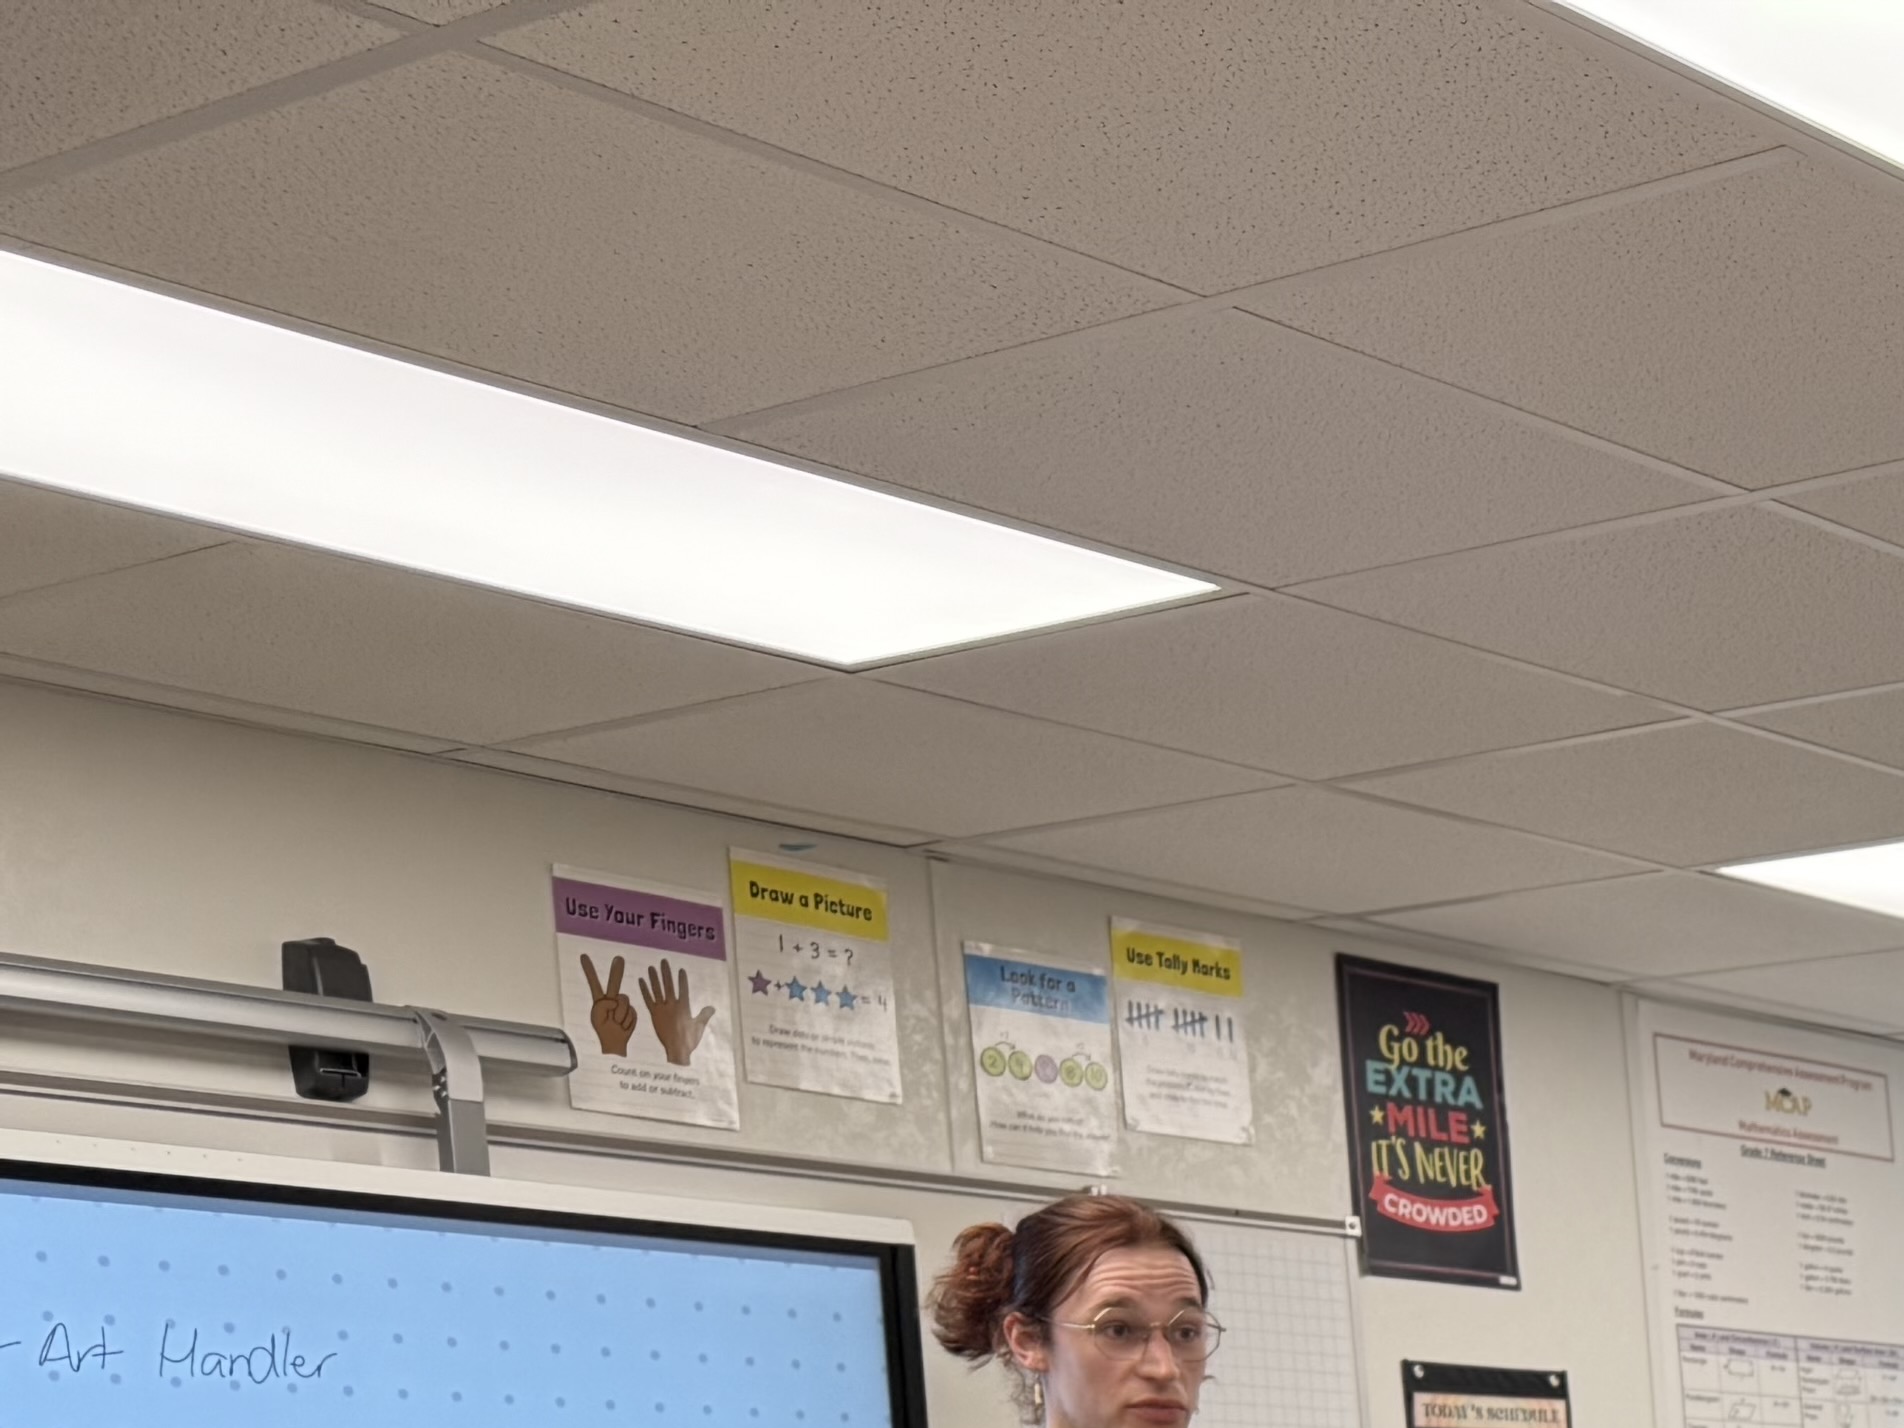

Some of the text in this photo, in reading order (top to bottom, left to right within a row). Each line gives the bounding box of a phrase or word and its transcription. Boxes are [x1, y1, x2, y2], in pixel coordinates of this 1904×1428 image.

[565, 897, 716, 940] Use Your Fingers
[749, 880, 873, 921] Draw a Picture
[1000, 965, 1076, 993] Look for a
[1126, 947, 1153, 967] Use
[1156, 951, 1188, 976] Tally
[1378, 1024, 1469, 1071] Go the
[1365, 1059, 1484, 1111] EXTRA
[1386, 1102, 1470, 1144] MILE
[1371, 1135, 1487, 1191] IT'S NEVER
[1383, 1192, 1488, 1227] CROWDED
[38, 1321, 339, 1385] Art Handler
